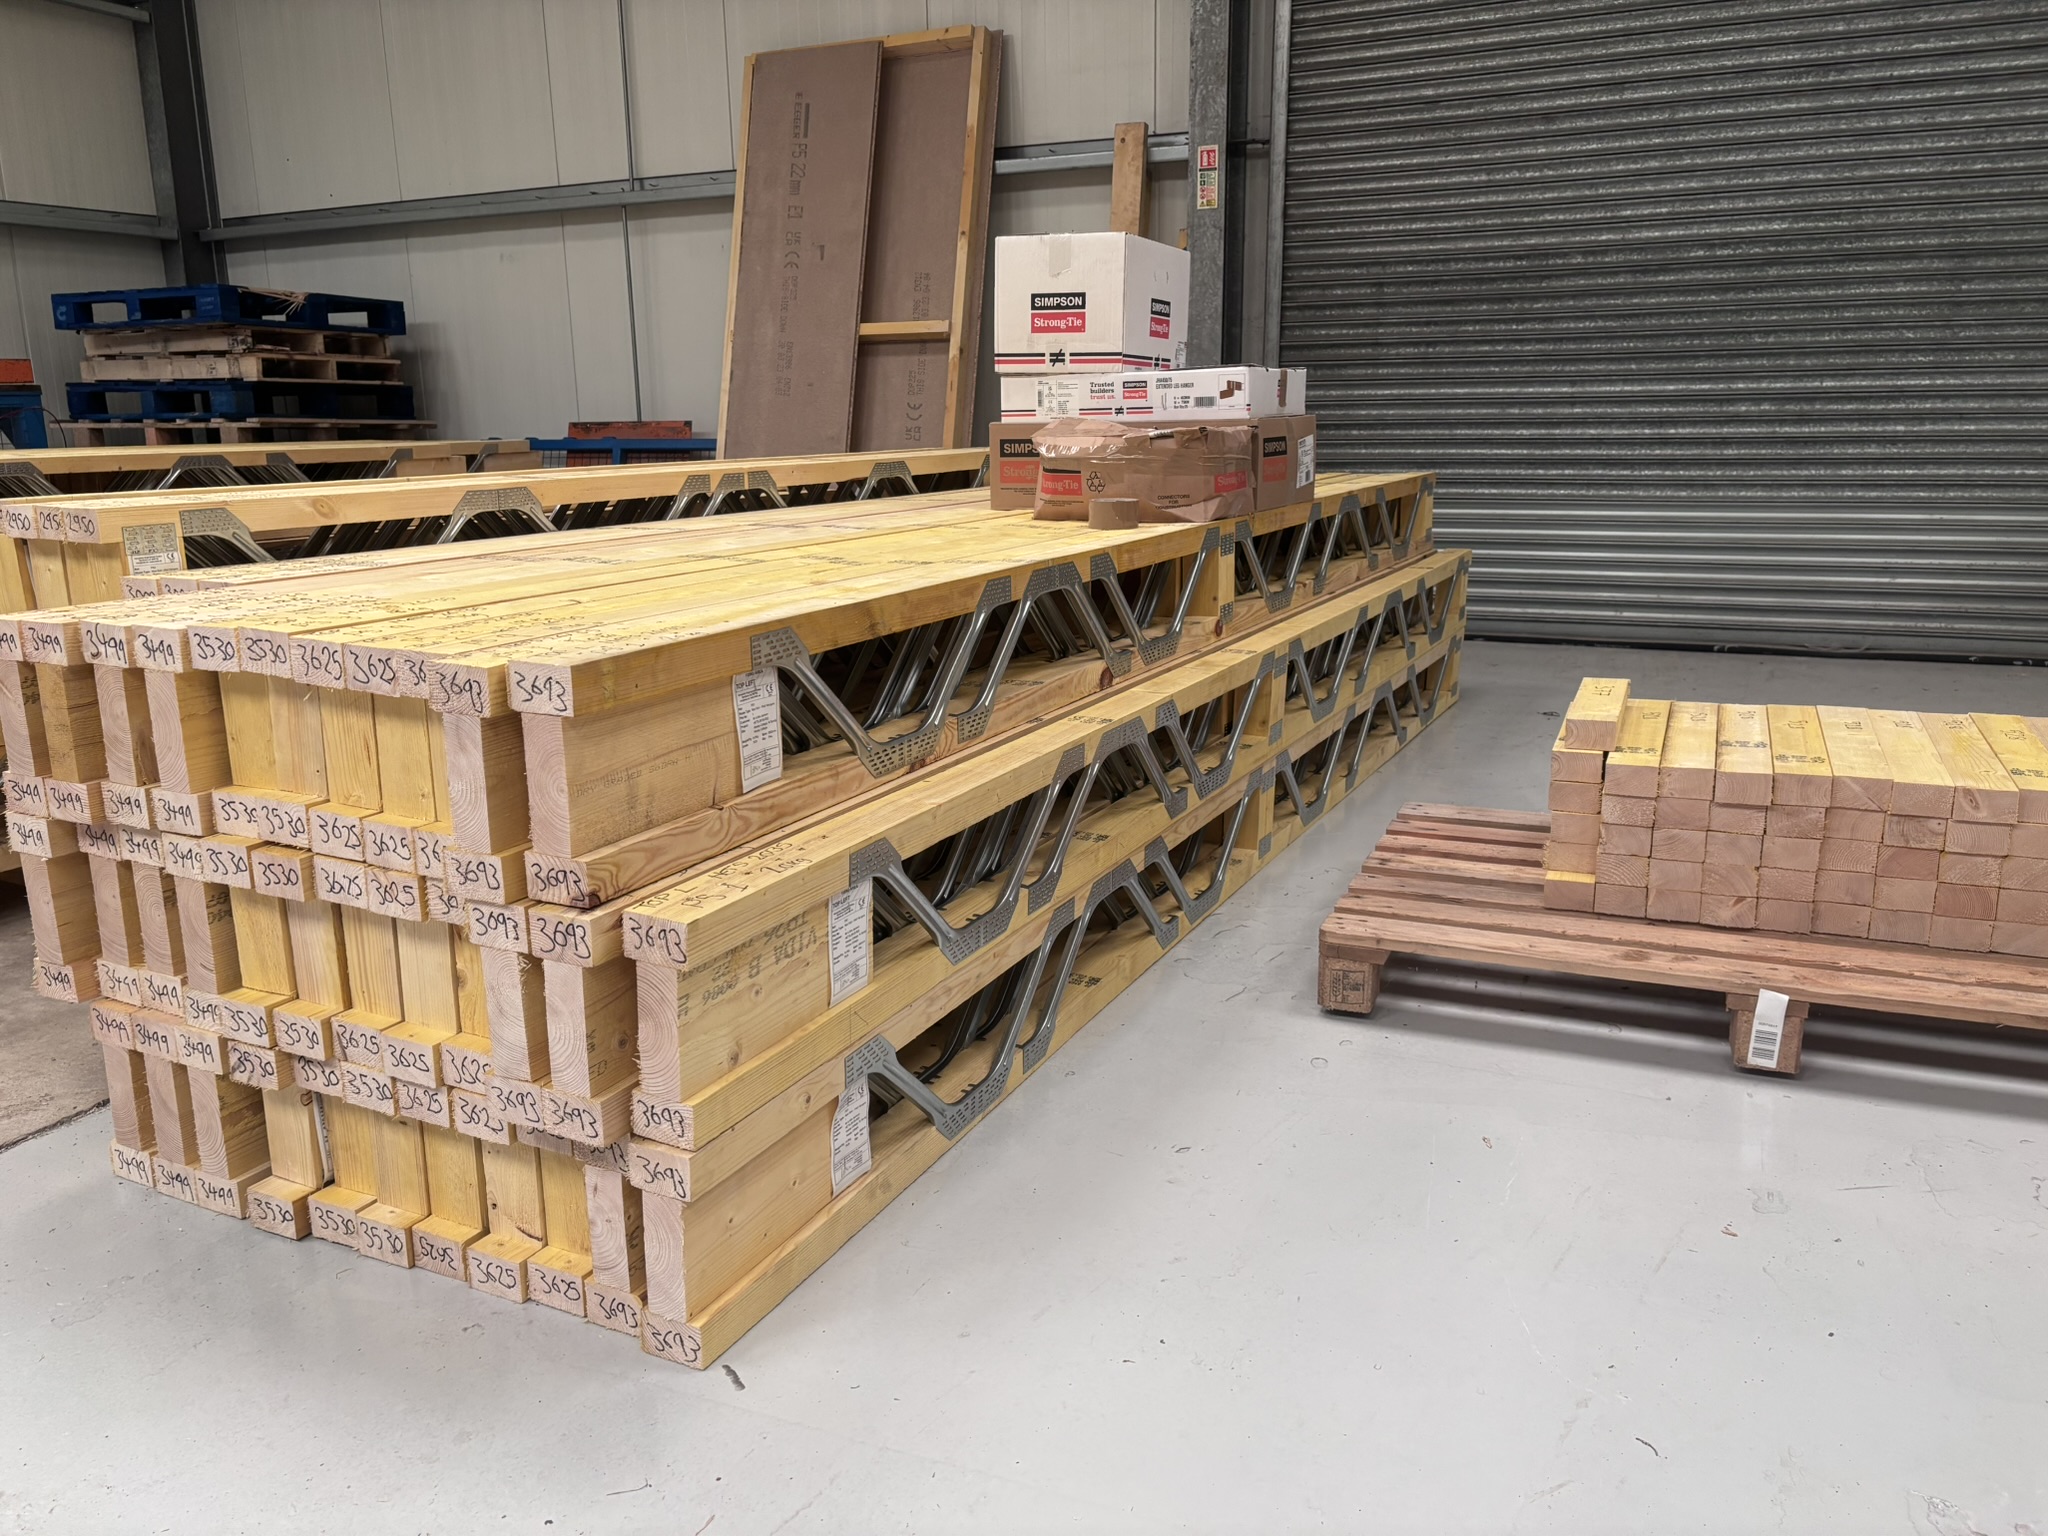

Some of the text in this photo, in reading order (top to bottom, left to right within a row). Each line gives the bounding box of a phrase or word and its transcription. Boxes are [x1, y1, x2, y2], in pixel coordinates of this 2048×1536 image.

[793, 103, 802, 139] EGGER
[1034, 296, 1083, 307] SIMPSON
[1152, 302, 1170, 314] SIMPSON
[1034, 317, 1082, 329] Strong-Tie
[1003, 443, 1038, 454] SIMPS
[1264, 442, 1287, 454] SIMPSON
[1042, 478, 1079, 490] trong-Tie
[6, 510, 31, 532] 2950
[66, 512, 96, 536] 2950
[28, 627, 63, 654] 3499
[87, 622, 127, 664] 3499
[138, 634, 177, 666] 3499
[193, 633, 236, 661] 3530
[245, 637, 288, 664] 3530
[297, 643, 343, 680] 3625
[349, 650, 396, 685] 3625
[436, 671, 483, 714] 3693
[514, 671, 568, 712] 3693
[8, 779, 41, 803] 3499
[50, 788, 84, 813] 3499
[107, 789, 142, 815] 3499
[158, 798, 192, 827] 3499
[261, 805, 305, 836] 3530
[12, 823, 43, 846] 3499
[84, 824, 118, 850] 3499
[124, 829, 160, 854] 3499
[318, 815, 362, 849] 3625
[369, 829, 412, 861] 3625
[206, 849, 248, 875] 3530
[258, 862, 299, 887] 3530
[451, 857, 500, 890] 3693
[321, 867, 363, 900] 3625
[370, 872, 416, 908] 3625
[531, 862, 589, 902] 3693
[539, 917, 592, 959] 3693
[629, 917, 687, 964] 3693
[40, 965, 72, 990] 3499
[101, 963, 140, 991] 3499
[144, 975, 181, 1007] 3499
[92, 1007, 130, 1043] 3499
[135, 1022, 170, 1053] 3499
[223, 1007, 268, 1038] 3530
[280, 1019, 320, 1050] 3530
[179, 1033, 214, 1063] 3499
[337, 1024, 380, 1055] 3625
[235, 1047, 274, 1078] 3530
[297, 1056, 340, 1088] 3530
[388, 1044, 430, 1073] 3625
[346, 1070, 394, 1101] 3530
[402, 1084, 443, 1114] 3625
[491, 1086, 540, 1123] 3693
[549, 1097, 599, 1139] 3693
[636, 1100, 685, 1138] 3693
[114, 1149, 149, 1183] 3499
[636, 1155, 686, 1199] 3693
[157, 1165, 195, 1201] 3499
[198, 1178, 235, 1208] 3499
[253, 1197, 294, 1223] 3530
[315, 1206, 356, 1235] 3530
[360, 1221, 404, 1254] 3530
[471, 1256, 518, 1290] 3625
[535, 1268, 581, 1302] 3625
[594, 1292, 638, 1329] 3693
[647, 1323, 701, 1363] 3693
